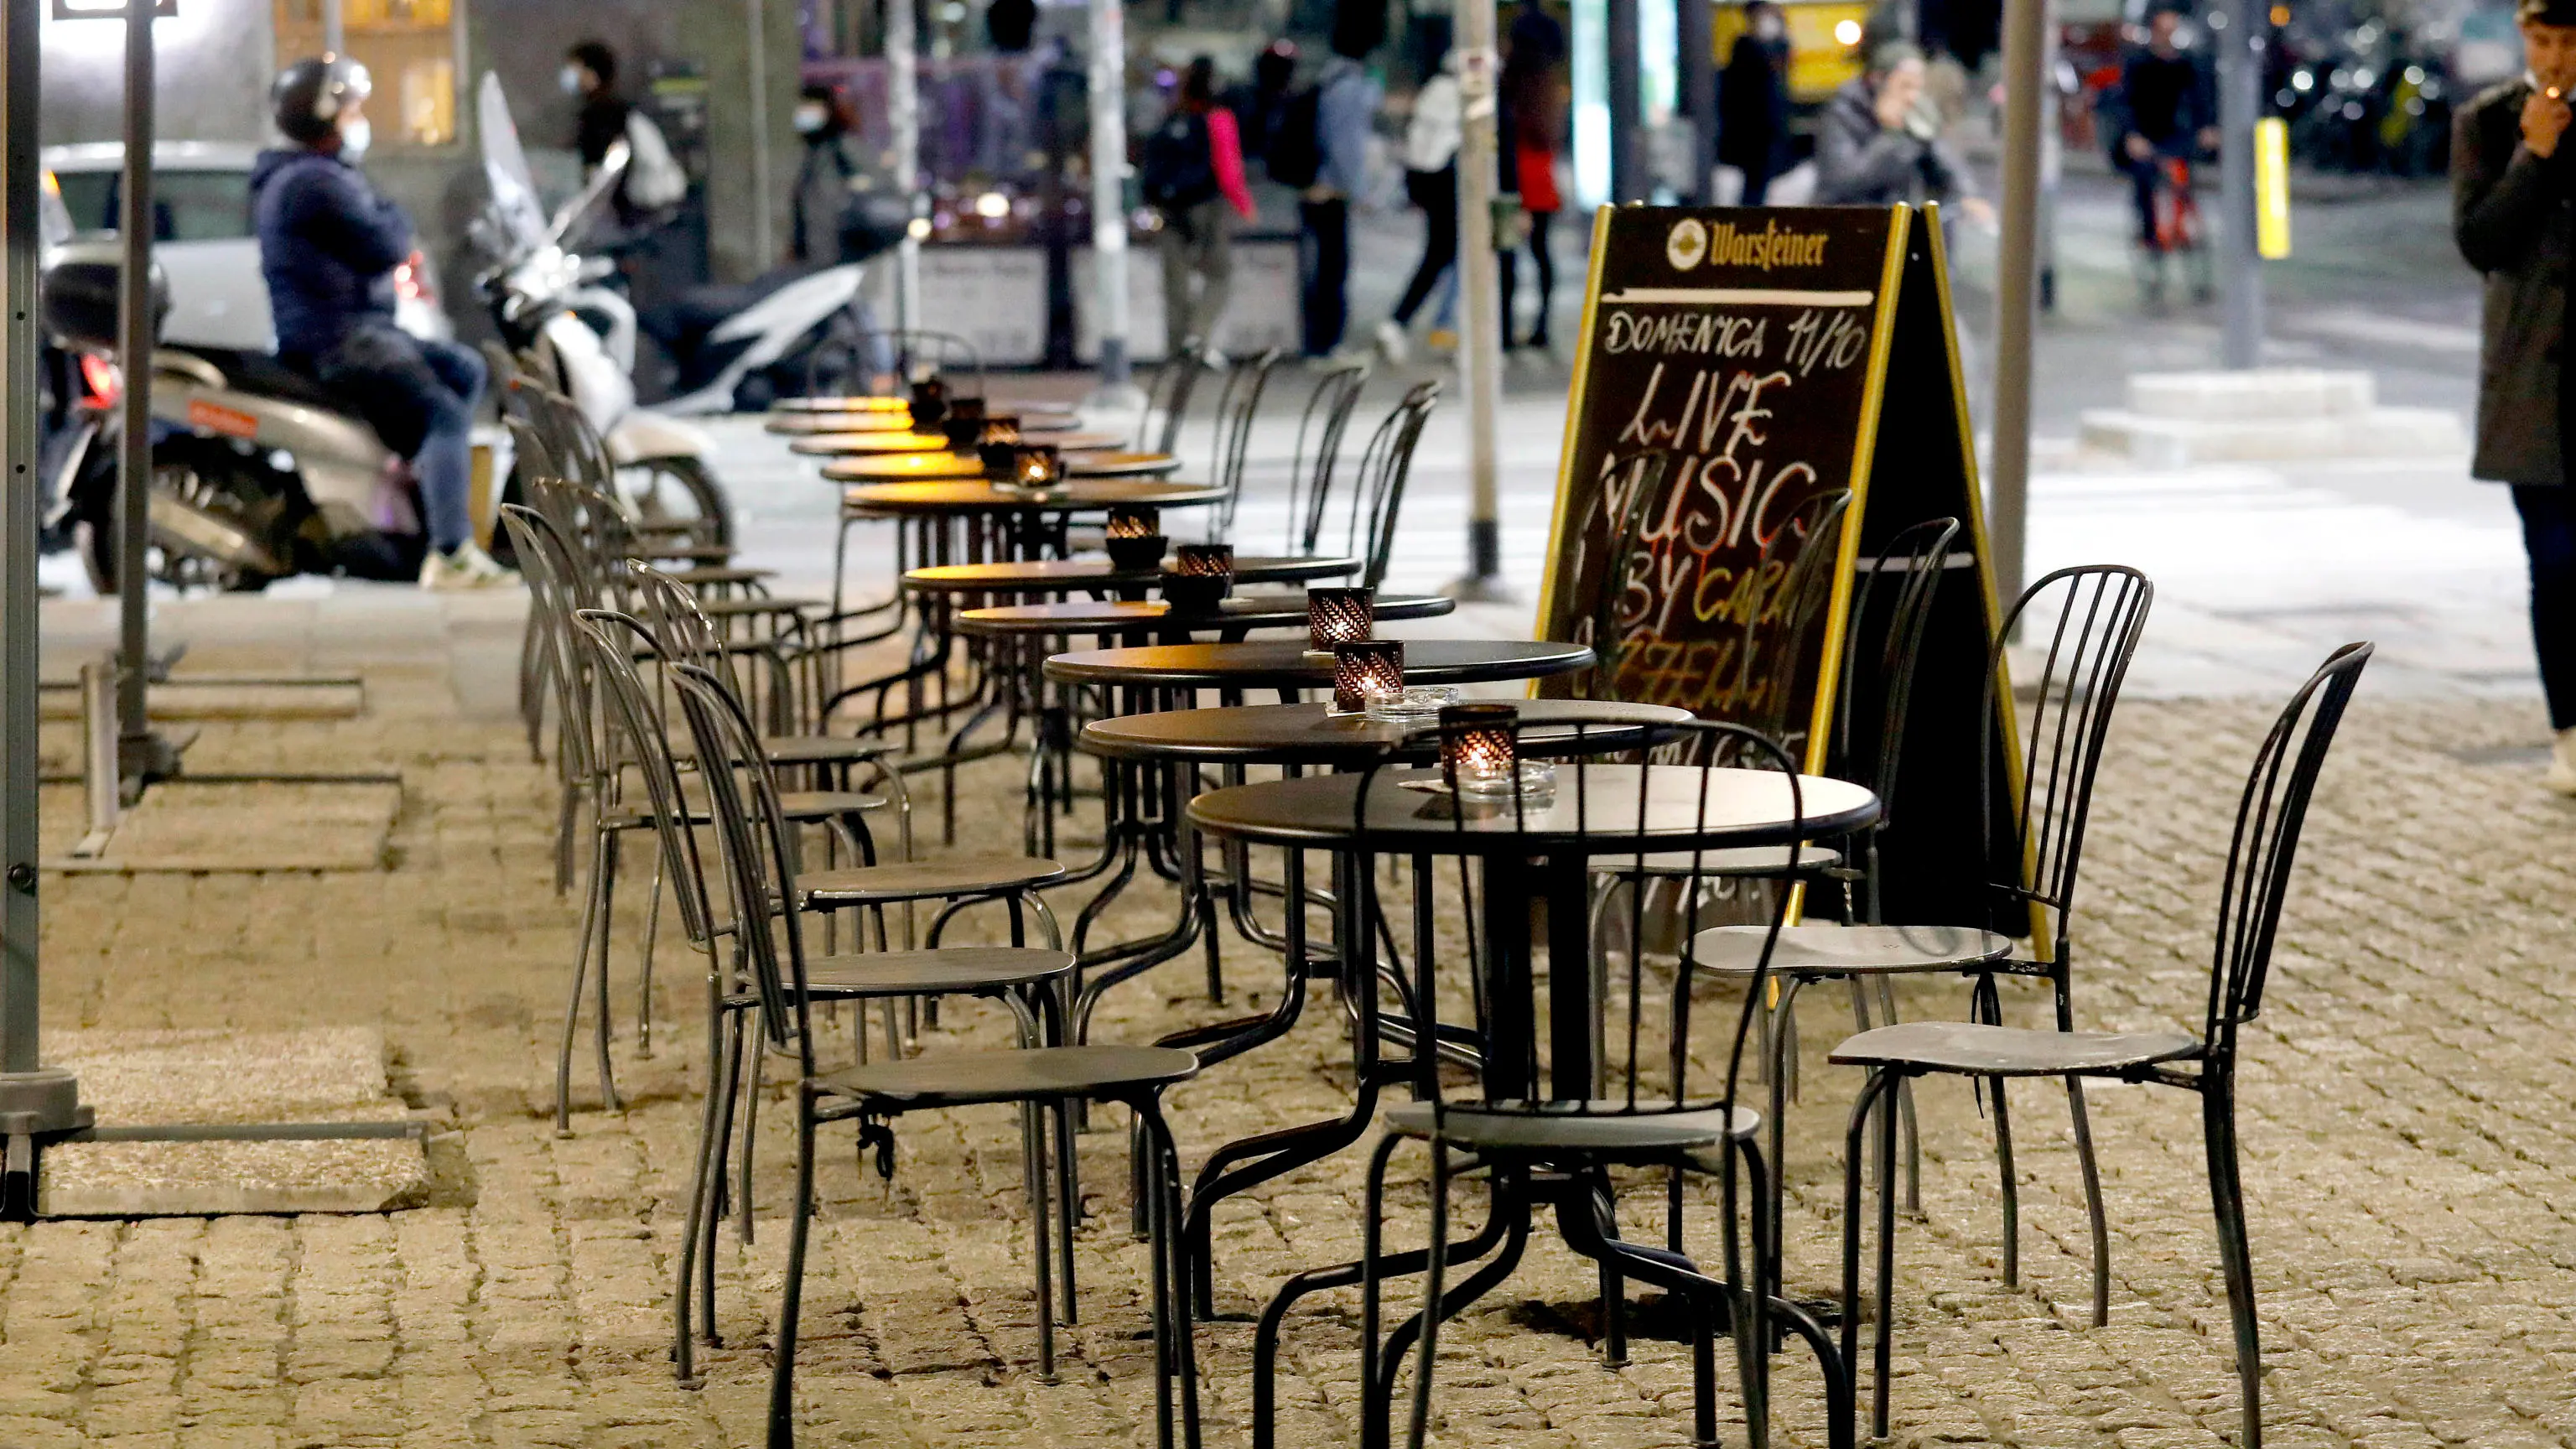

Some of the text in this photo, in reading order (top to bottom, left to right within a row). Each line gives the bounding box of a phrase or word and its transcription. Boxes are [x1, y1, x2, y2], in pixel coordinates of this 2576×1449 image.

[1708, 217, 1829, 273] Warsteiner
[1604, 308, 1867, 378] DOMENICA 11/10
[1618, 361, 1792, 456] LIVE
[1587, 451, 1818, 551] MUSIC
[1614, 550, 1694, 636] BY
